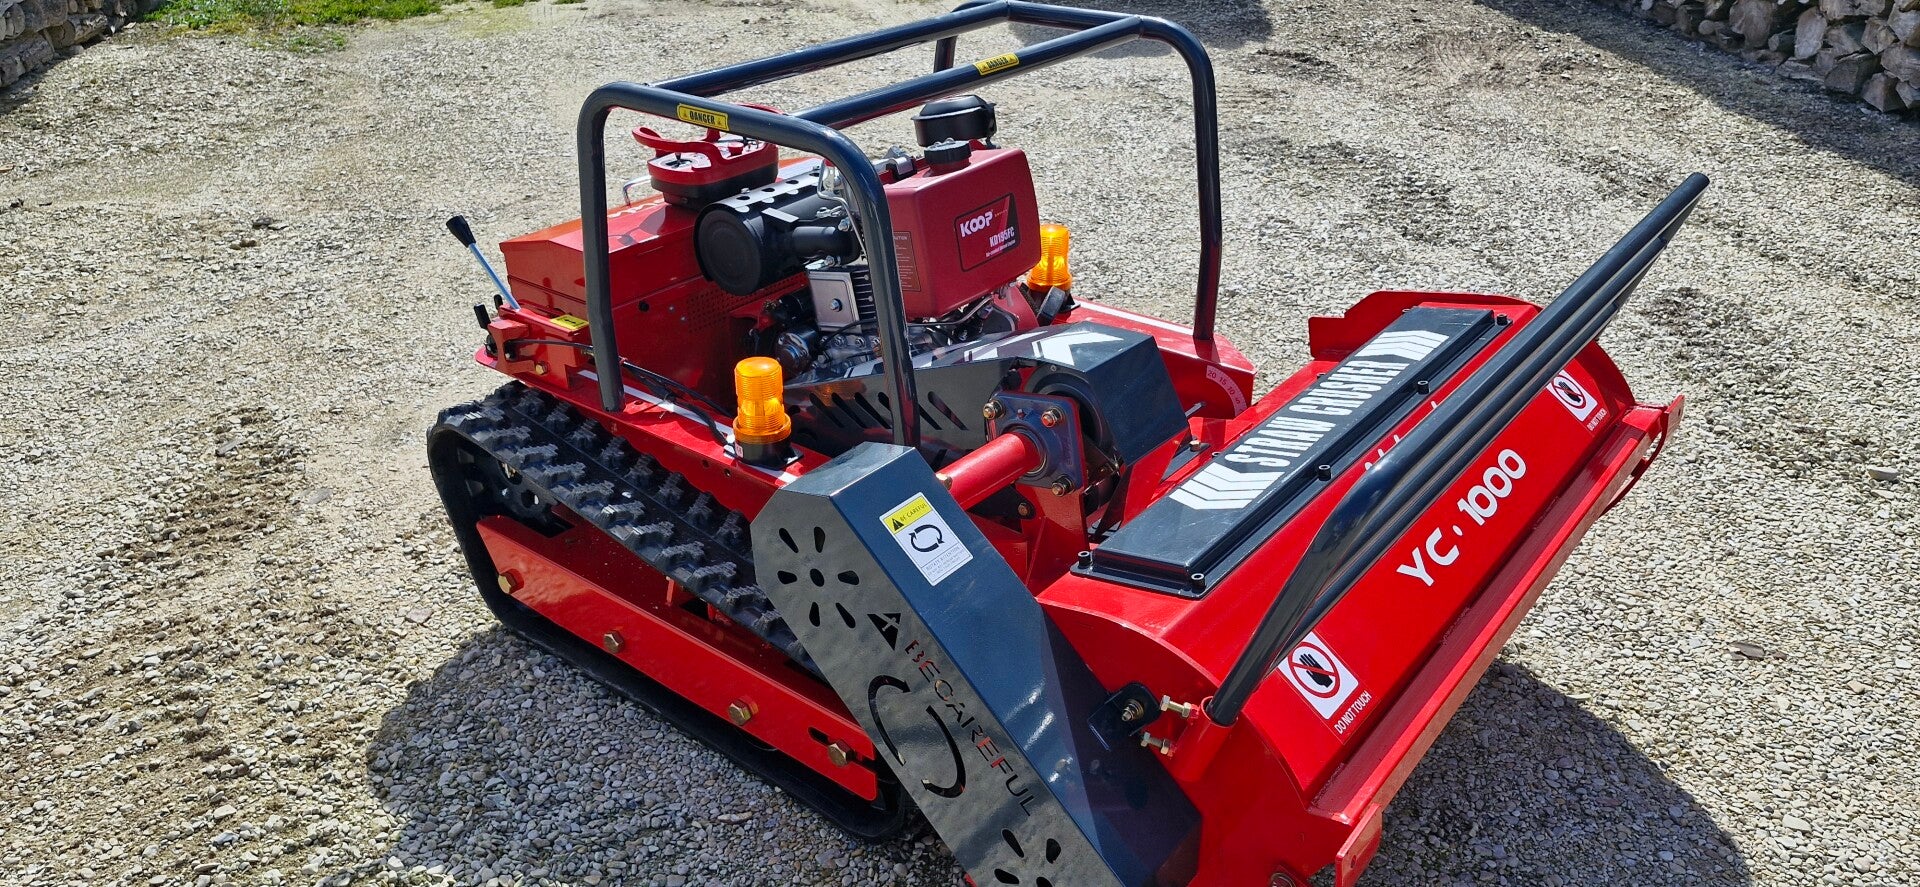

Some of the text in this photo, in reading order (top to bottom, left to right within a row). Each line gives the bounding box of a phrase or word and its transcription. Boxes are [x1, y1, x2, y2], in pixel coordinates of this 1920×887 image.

[986, 56, 1009, 69] DANGER
[689, 110, 716, 125] DANGER
[960, 211, 993, 237] KOOP
[1208, 369, 1216, 378] 20
[1219, 377, 1227, 385] 15
[1227, 387, 1235, 395] 10
[1223, 416, 1337, 468] STRAW
[1289, 359, 1410, 416] CRUSHER
[1457, 448, 1527, 526] 1000
[907, 503, 927, 517] CAREFUL
[1334, 690, 1372, 734] DO NOT TOUCH
